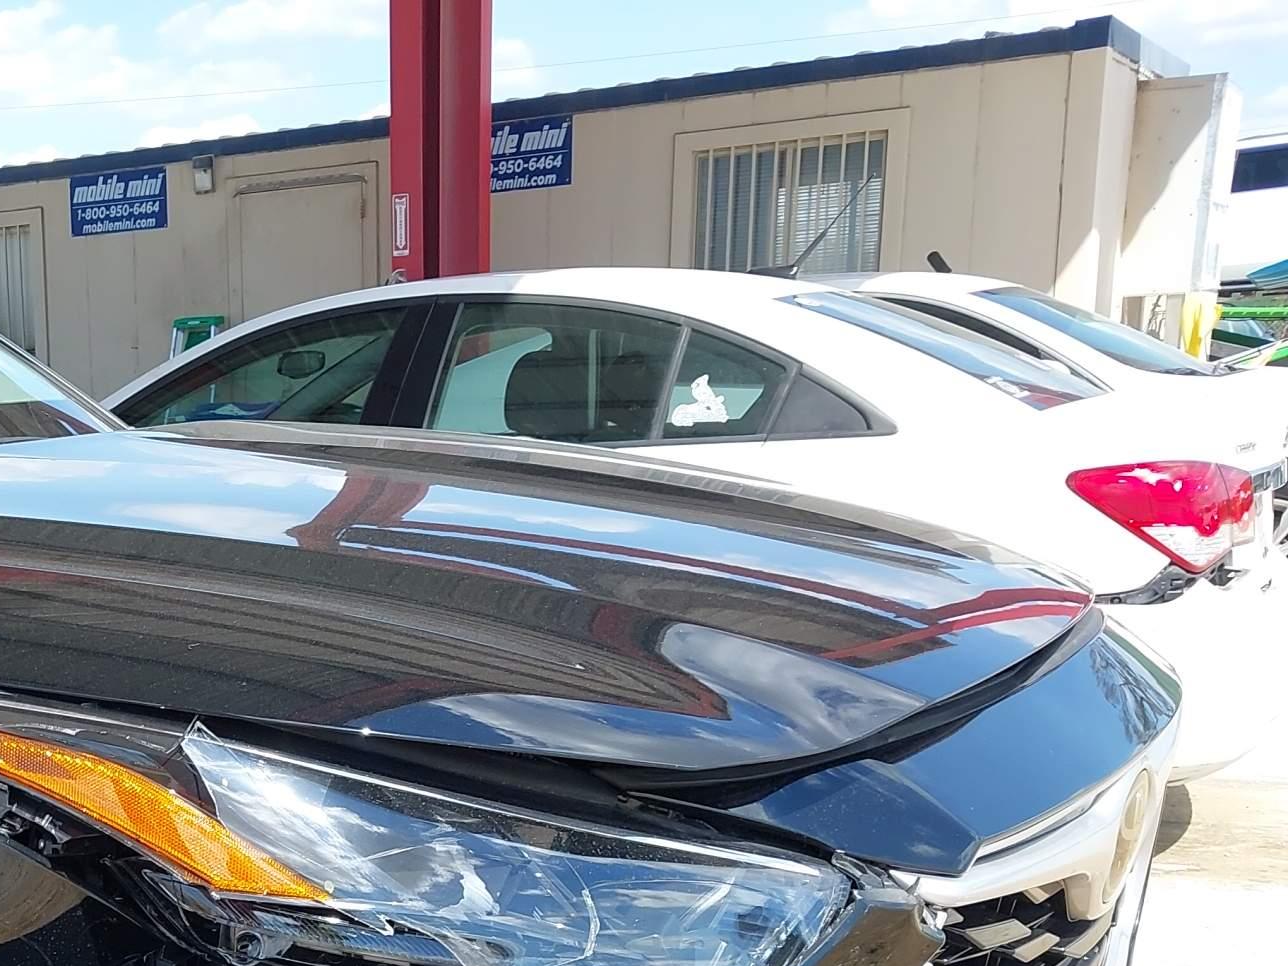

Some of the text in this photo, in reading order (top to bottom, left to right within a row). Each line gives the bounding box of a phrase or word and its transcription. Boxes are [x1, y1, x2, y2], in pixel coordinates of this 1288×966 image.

[491, 122, 569, 155] ile mini
[73, 173, 165, 203] mobile mini
[77, 200, 160, 221] 1-800-950-6464
[82, 217, 156, 234] mobilemini.com
